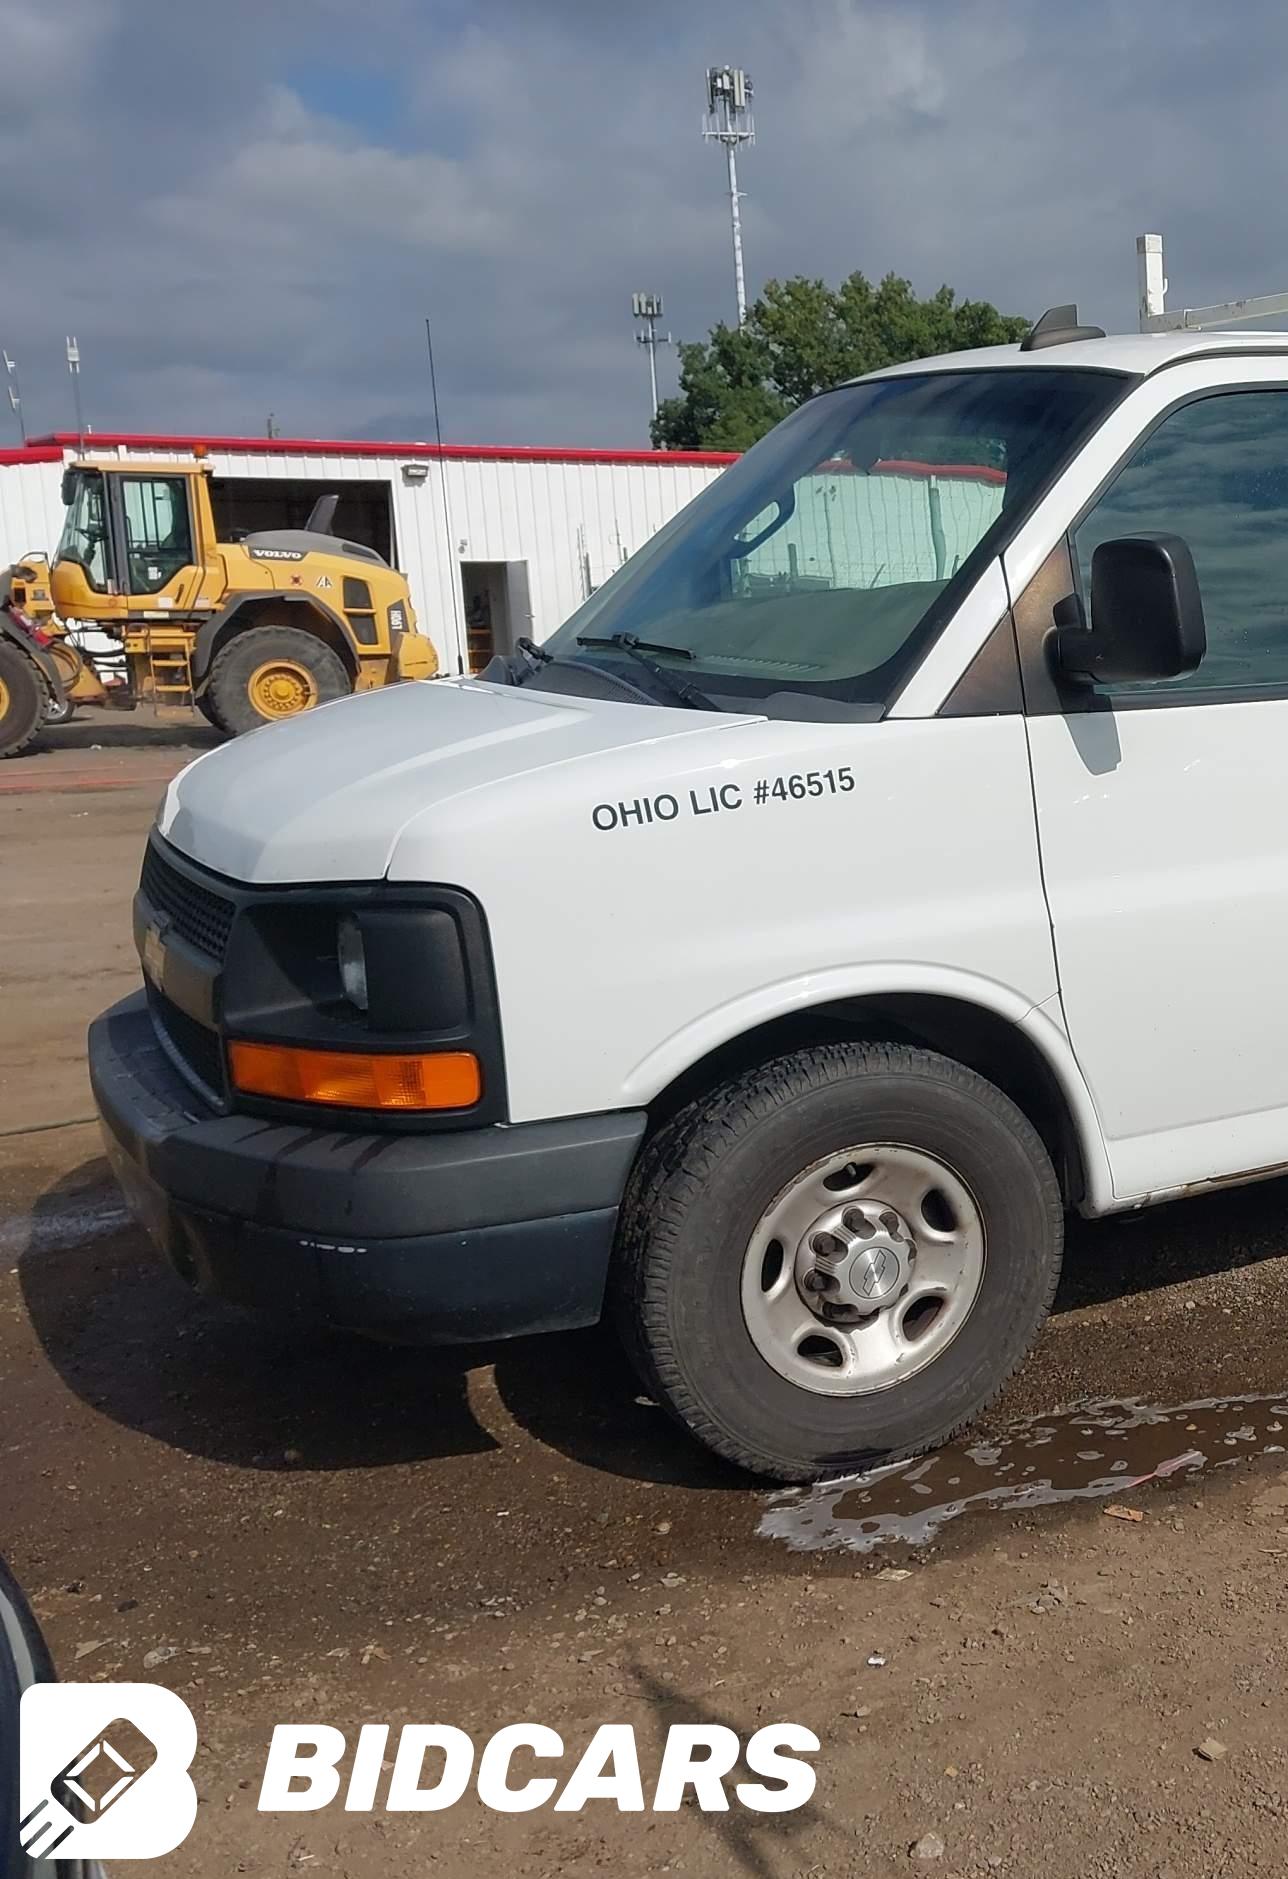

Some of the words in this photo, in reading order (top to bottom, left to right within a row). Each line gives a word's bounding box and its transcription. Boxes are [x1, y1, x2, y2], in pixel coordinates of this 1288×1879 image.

[252, 549, 303, 560] VOLVO
[592, 794, 679, 831] OHIO
[689, 783, 743, 815] LIC
[752, 766, 855, 805] #46515
